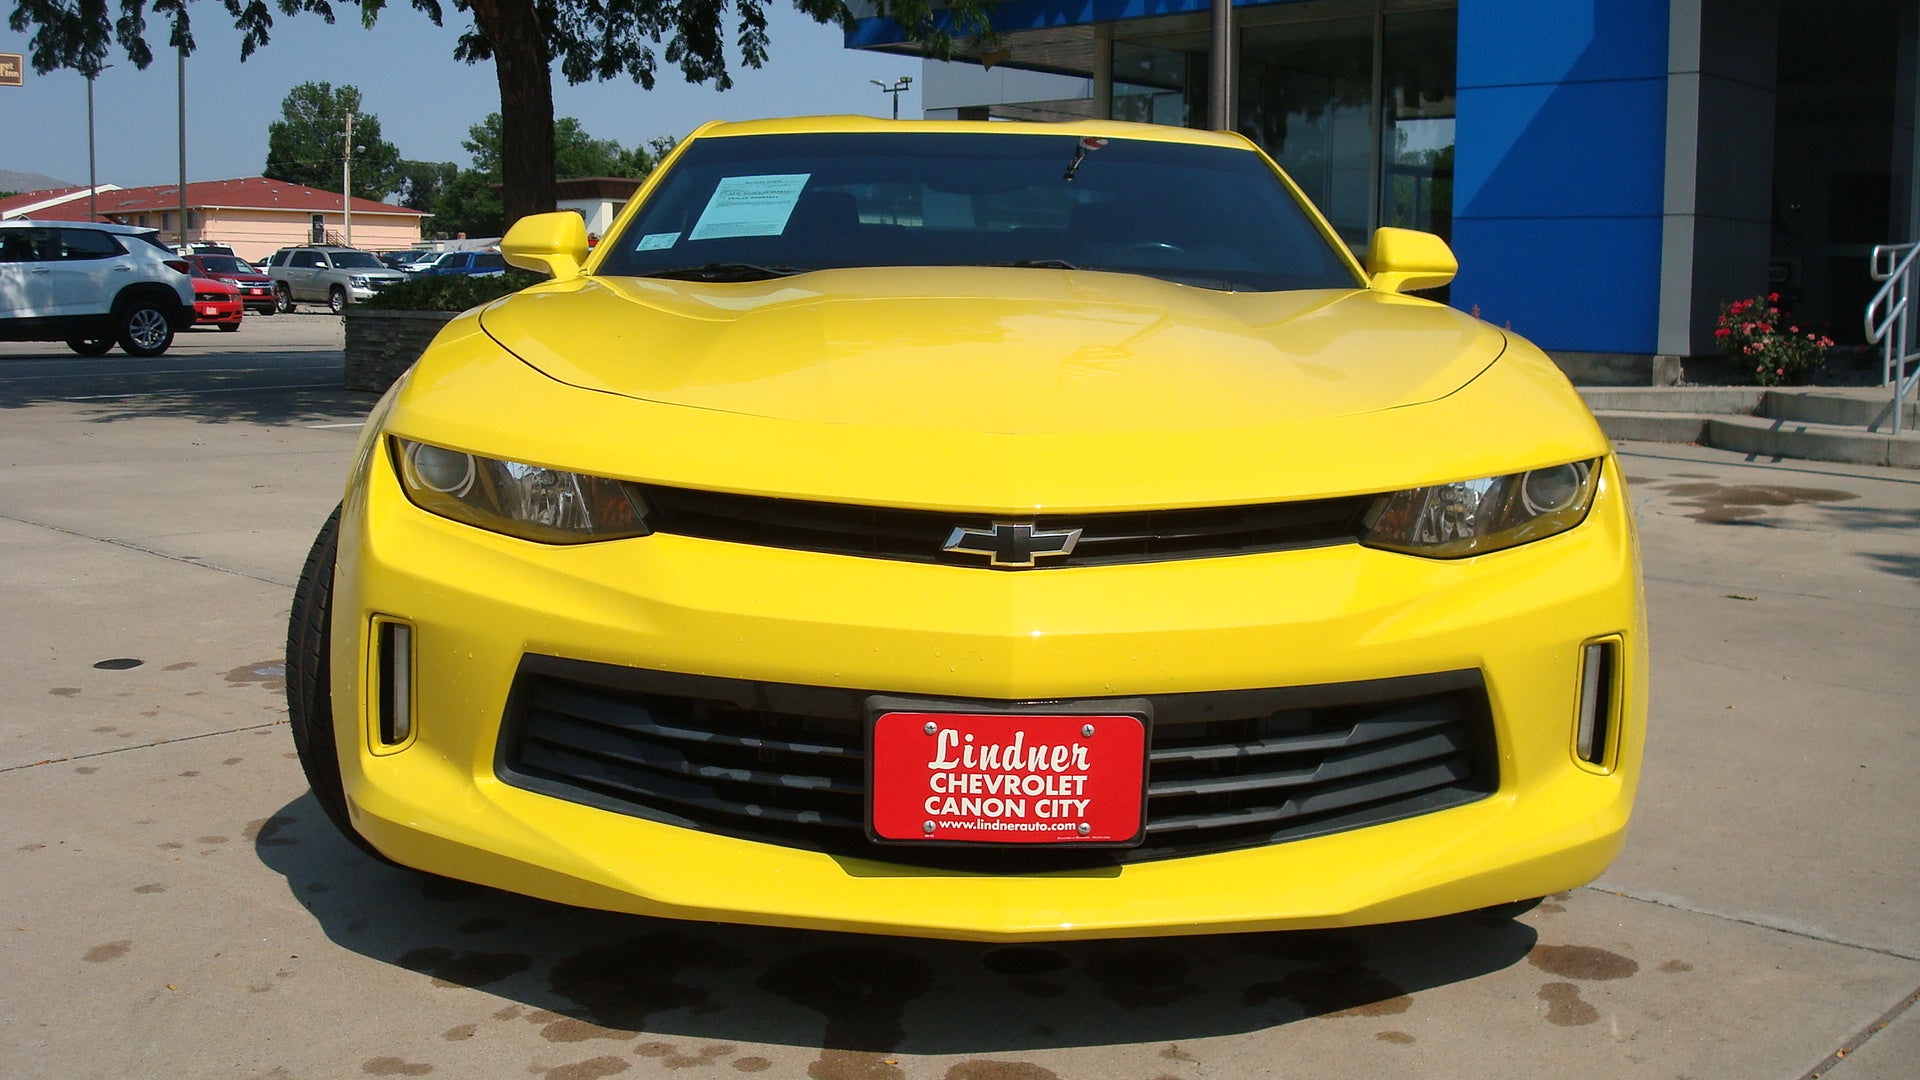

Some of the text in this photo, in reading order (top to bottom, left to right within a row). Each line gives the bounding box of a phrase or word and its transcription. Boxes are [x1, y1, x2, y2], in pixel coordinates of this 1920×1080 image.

[928, 728, 1091, 773] Lindner
[930, 773, 1088, 796] CHEVROLET
[924, 796, 1091, 818] CANON CITY
[938, 819, 1077, 832] www.lindnerauto.com
